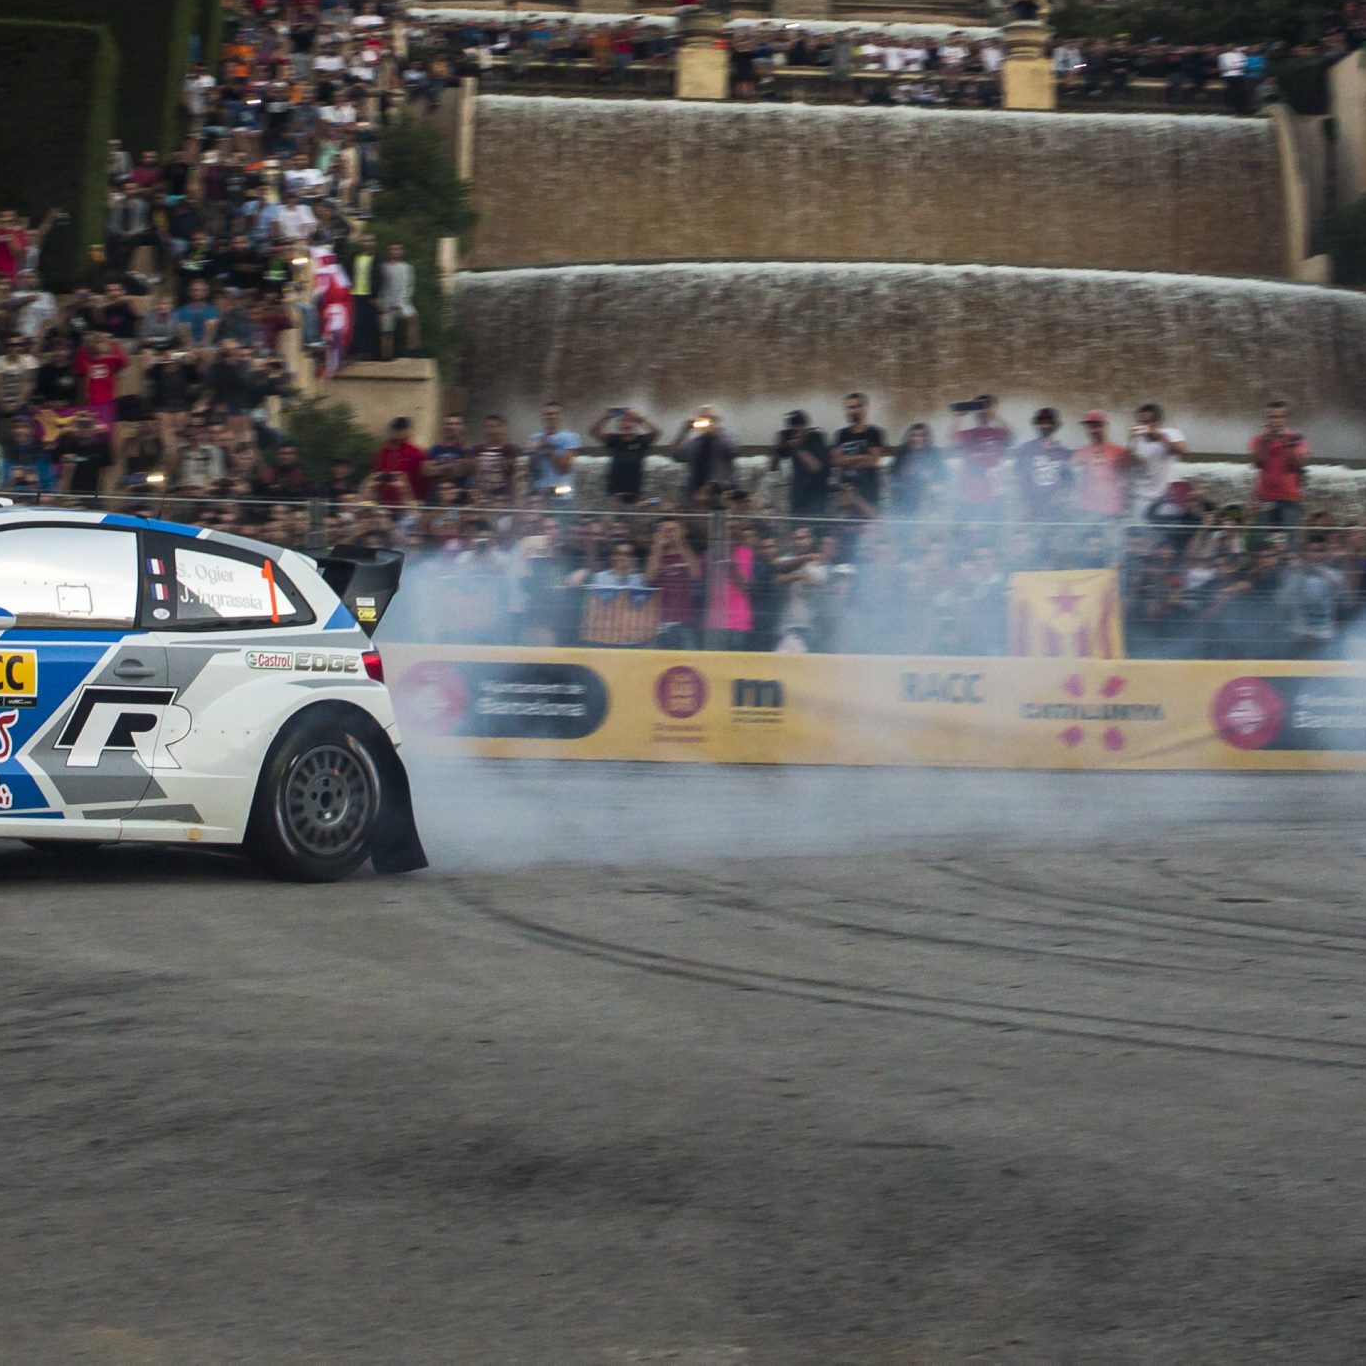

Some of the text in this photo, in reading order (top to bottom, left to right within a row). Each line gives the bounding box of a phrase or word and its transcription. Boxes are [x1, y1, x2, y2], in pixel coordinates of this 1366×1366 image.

[195, 564, 235, 585] Ogier
[180, 587, 264, 611] J. Ingrassia
[261, 558, 280, 623] 1
[257, 652, 359, 674] Castrol EDGE
[901, 672, 985, 703] RACC
